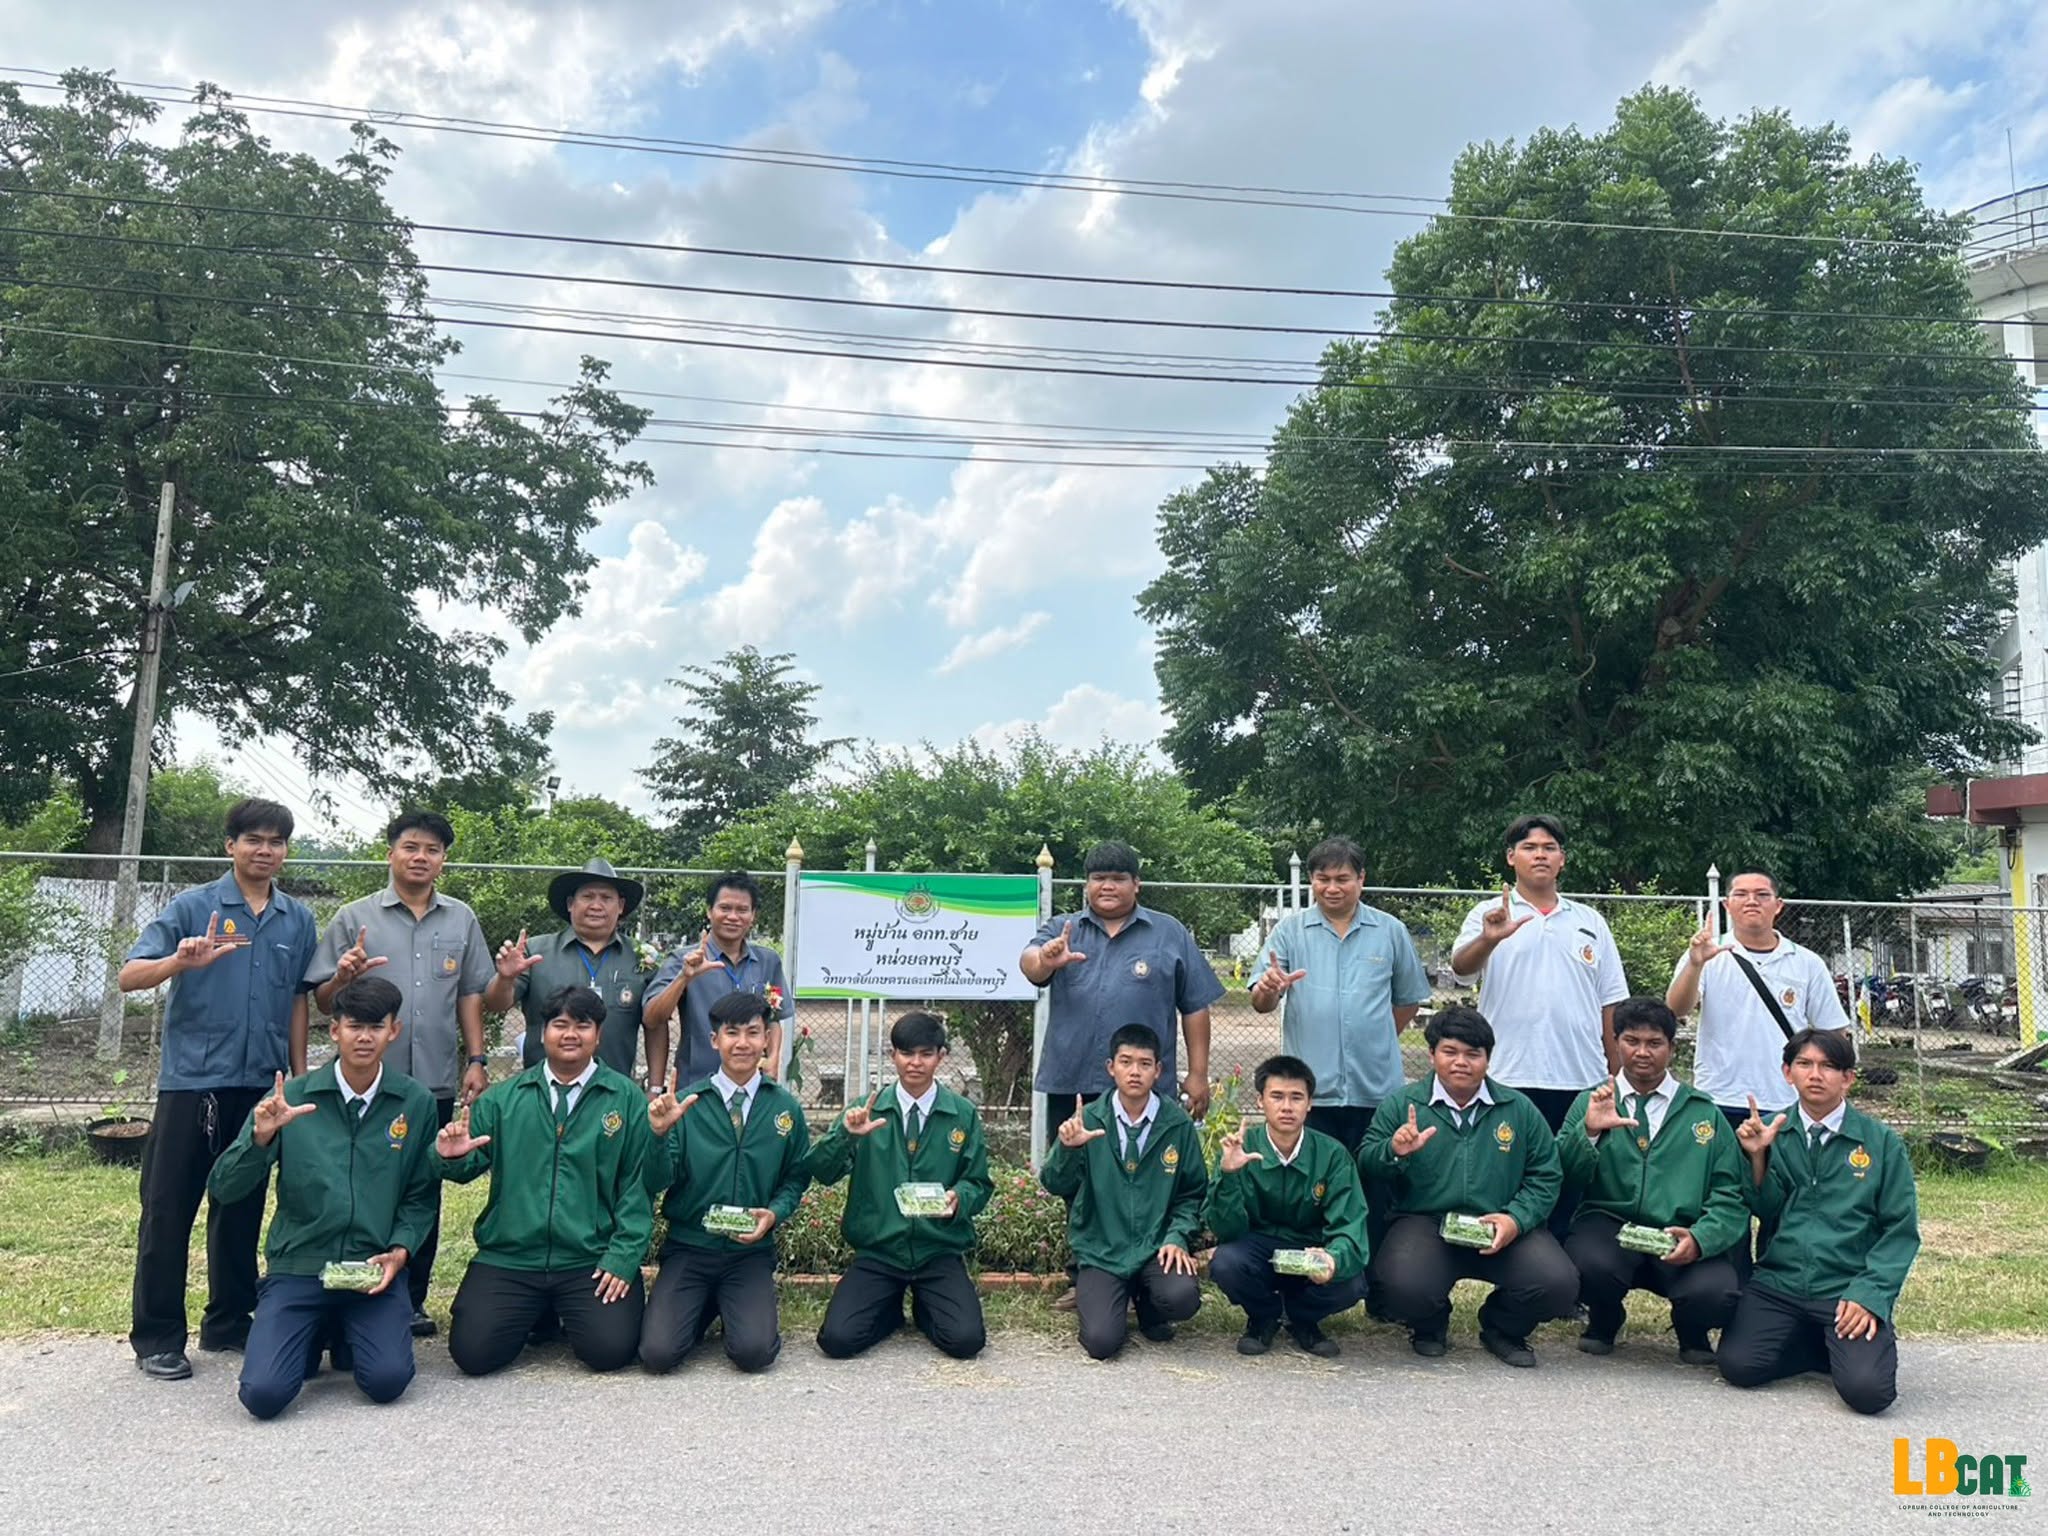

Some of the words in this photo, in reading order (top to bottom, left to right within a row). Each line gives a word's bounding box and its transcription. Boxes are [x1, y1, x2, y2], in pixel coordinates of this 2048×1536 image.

[854, 919, 907, 951] หมู่บ้าน
[912, 920, 979, 941] อกท.ชาย
[876, 942, 963, 969] หน่วยลพบุรี
